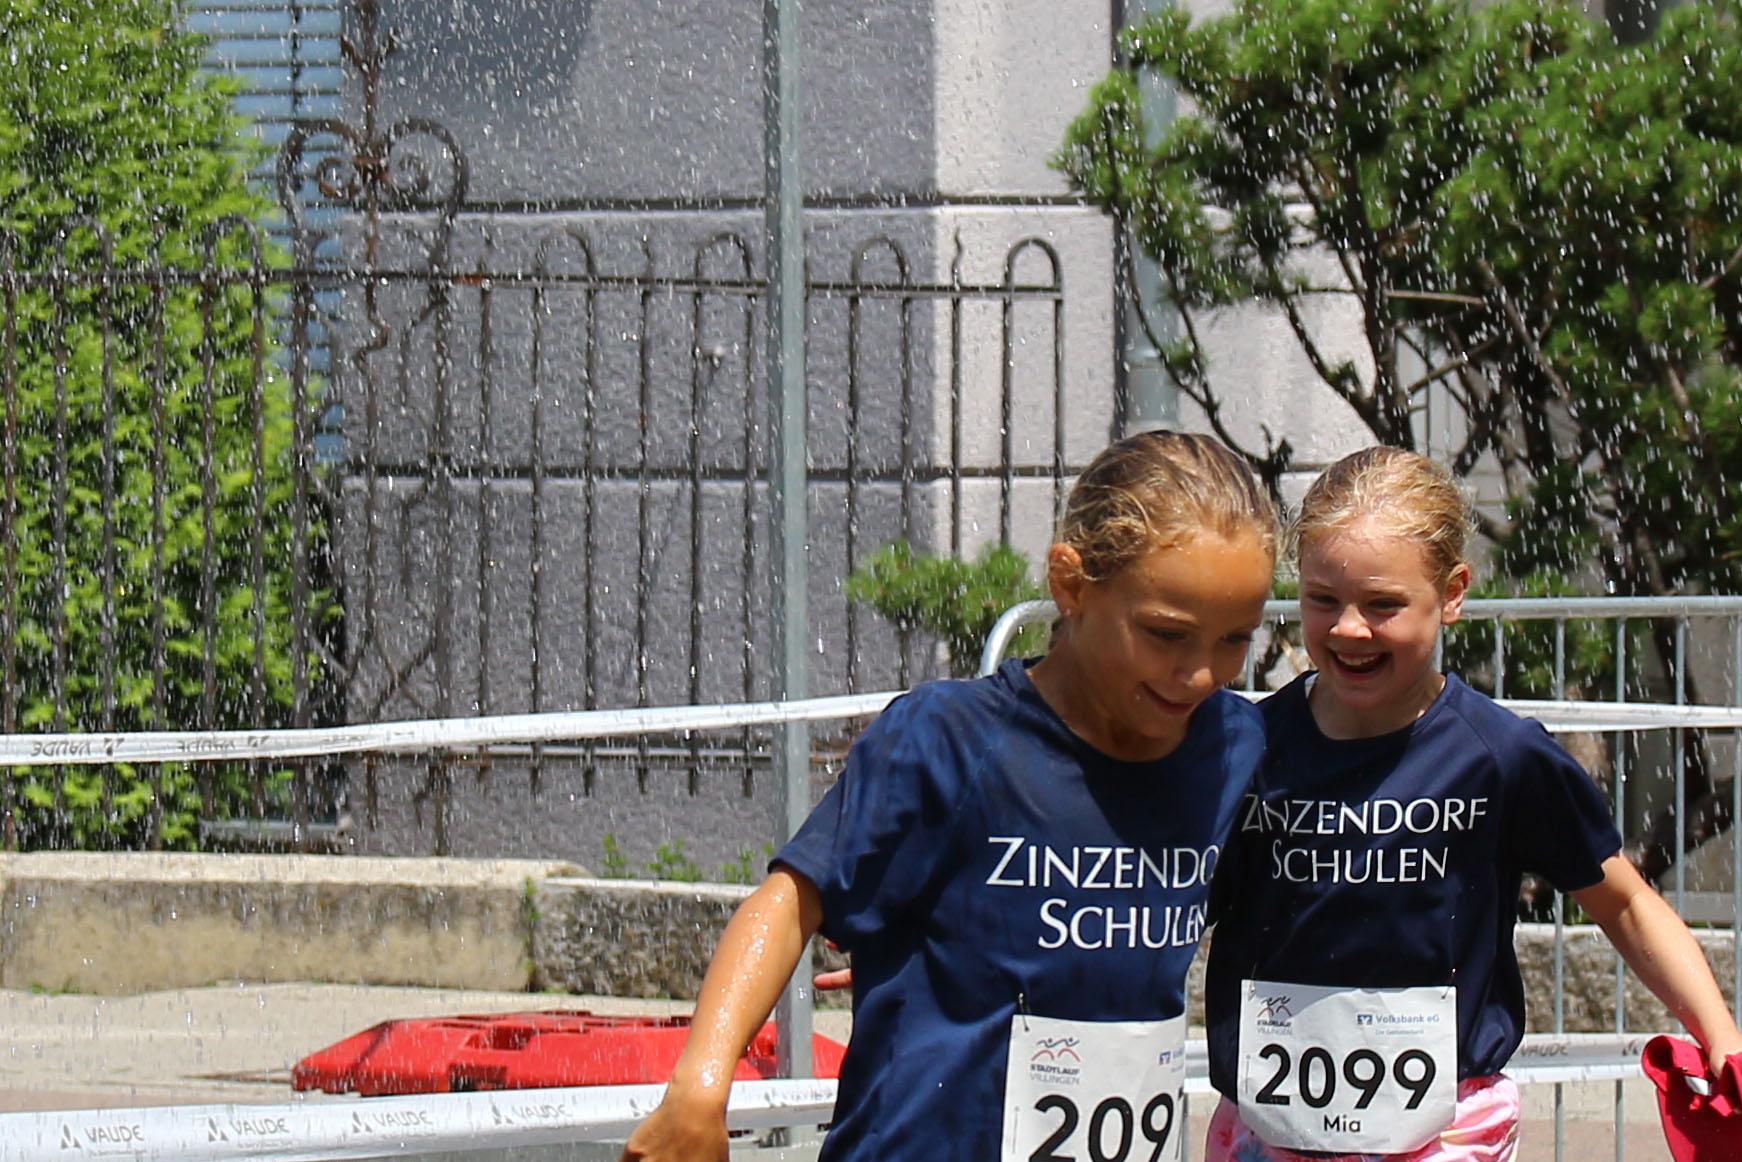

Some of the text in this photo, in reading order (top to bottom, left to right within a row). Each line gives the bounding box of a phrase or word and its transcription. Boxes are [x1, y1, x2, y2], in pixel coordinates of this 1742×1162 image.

[1241, 793, 1489, 836] ZINZENDORF
[1272, 839, 1449, 884] SCHULEN
[1375, 1014, 1425, 1023] Volksbank
[1030, 1063, 1081, 1077] STADTLAUF
[1255, 1043, 1437, 1110] 2099
[373, 1110, 434, 1127] VAUDE
[512, 1103, 573, 1121] VAUDE
[229, 1118, 291, 1136] VAUDE
[1323, 1114, 1362, 1133] Mia
[84, 1124, 145, 1143] VAUDE
